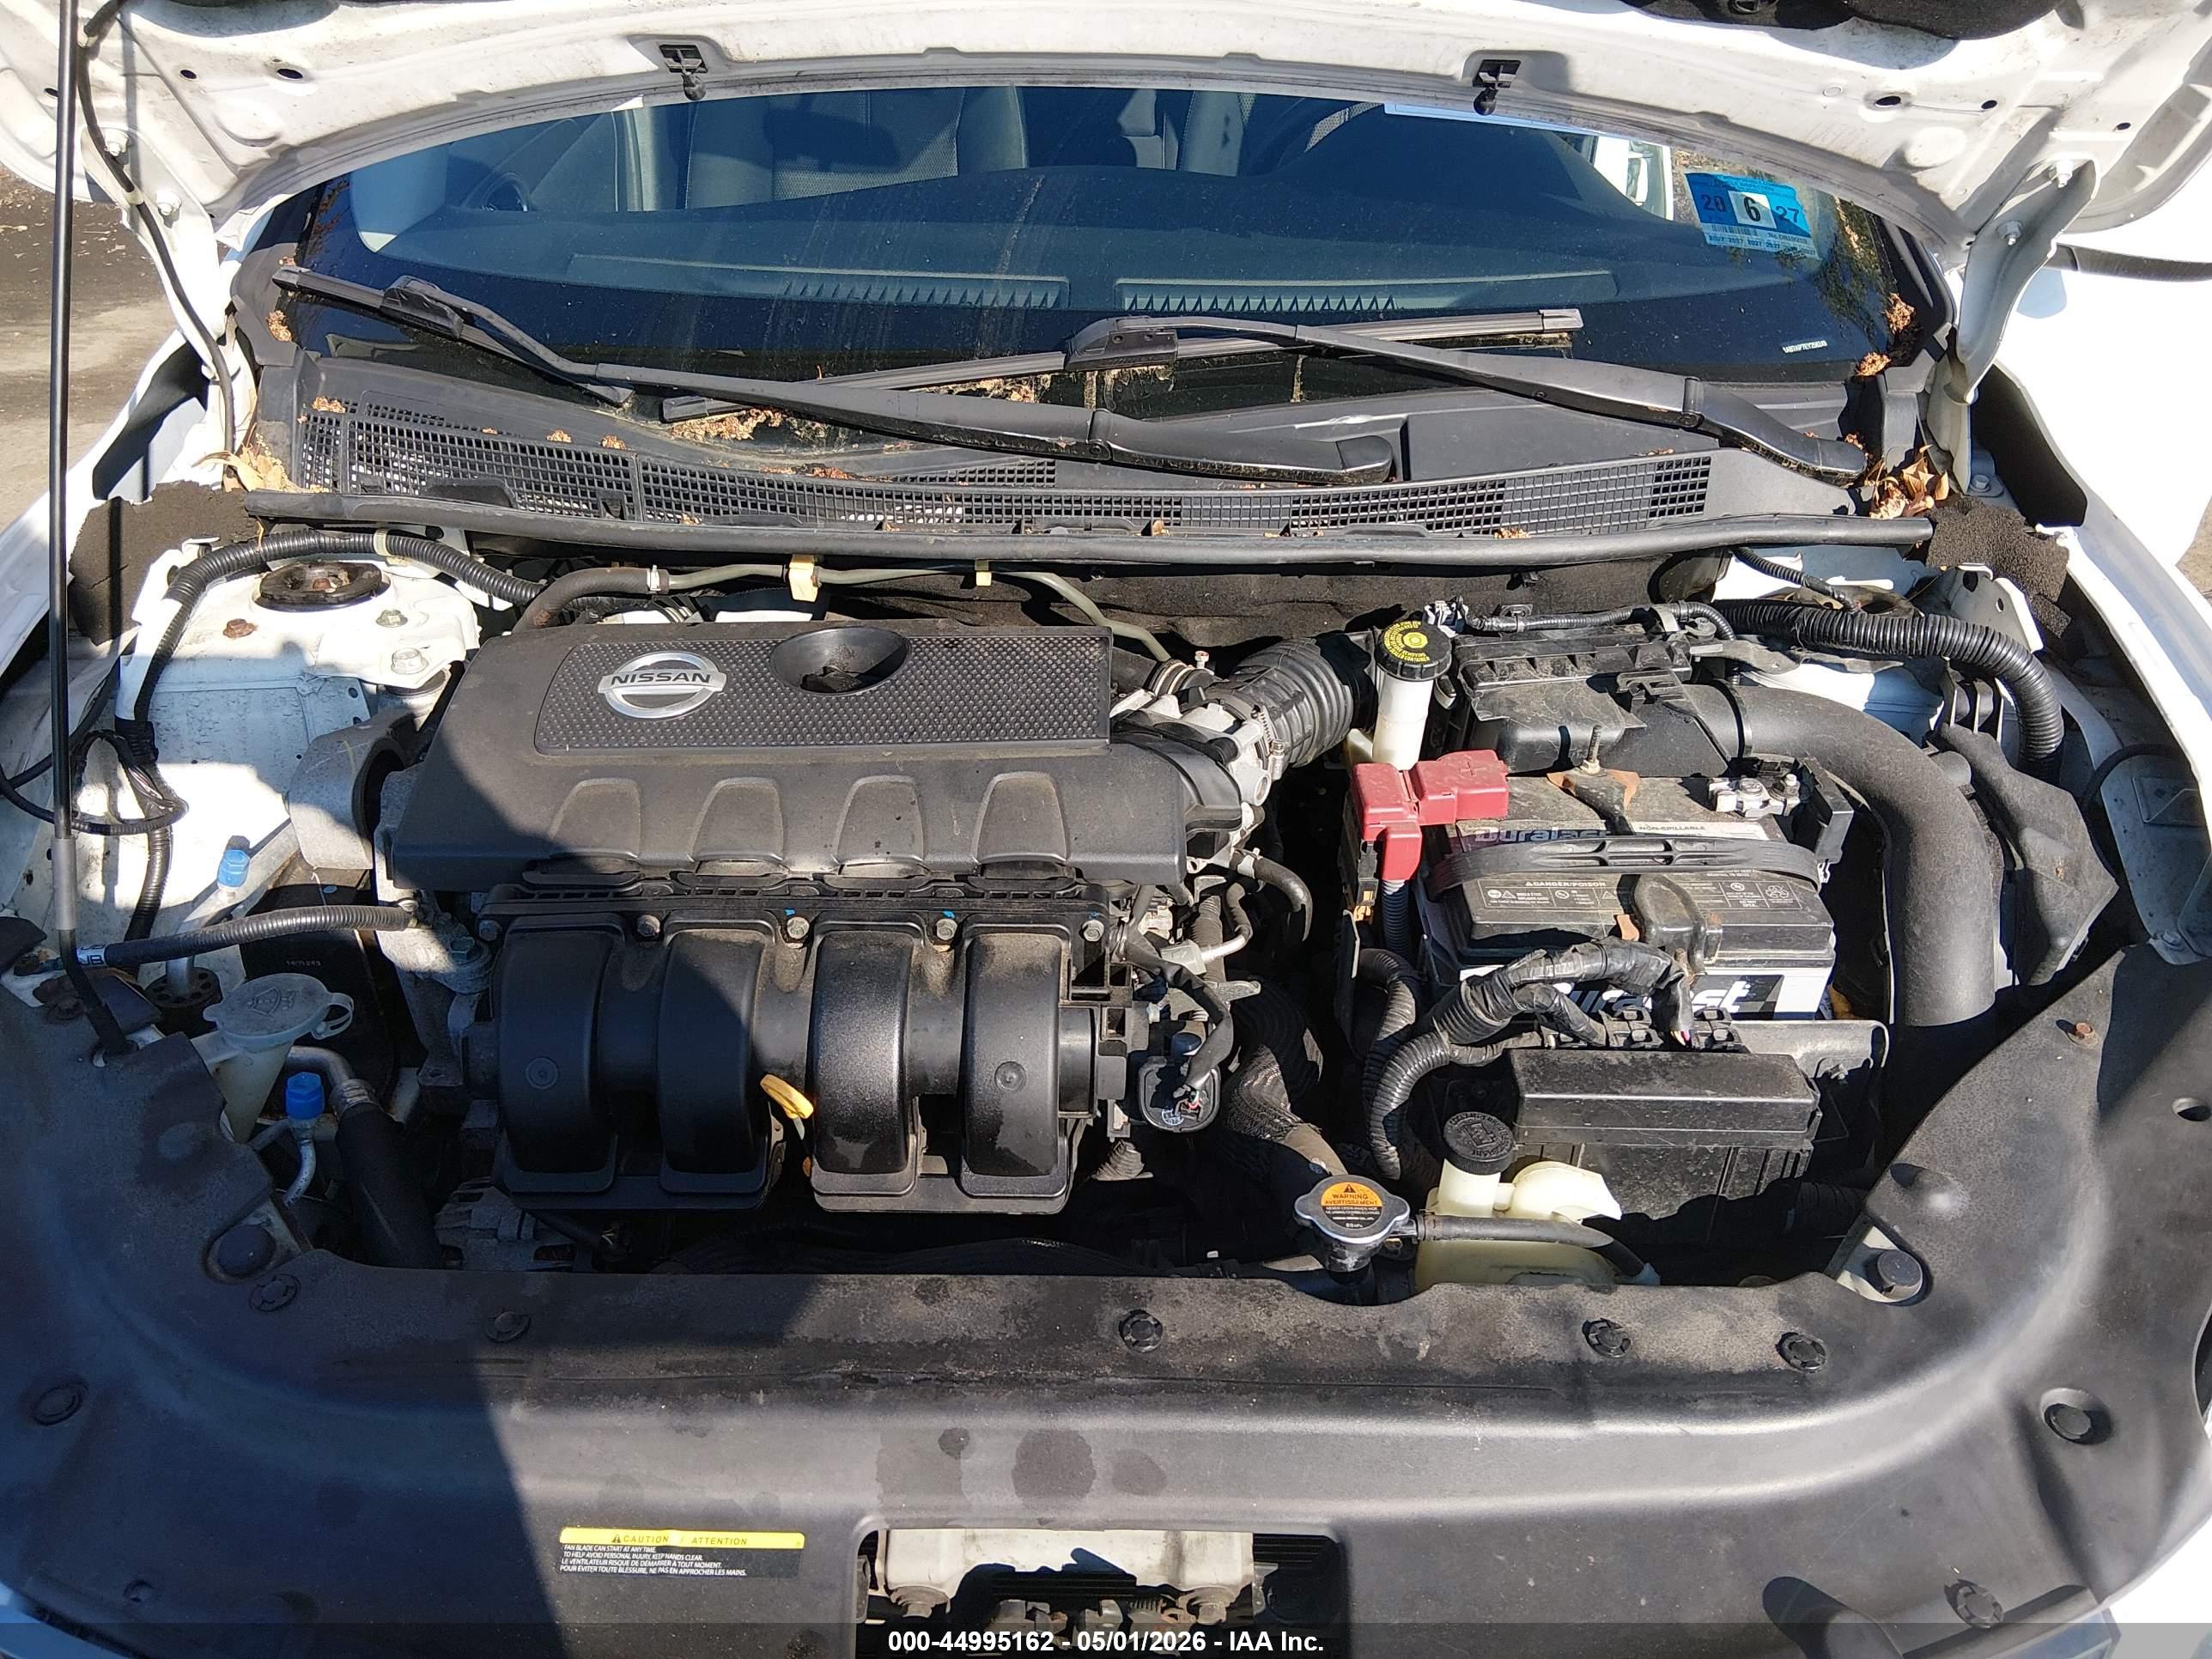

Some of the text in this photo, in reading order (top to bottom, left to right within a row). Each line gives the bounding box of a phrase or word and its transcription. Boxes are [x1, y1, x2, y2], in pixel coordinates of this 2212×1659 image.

[1700, 194, 1727, 212] 20
[1743, 196, 1761, 222] 6
[1776, 205, 1800, 223] 27
[611, 672, 711, 685] NISSAN
[623, 1534, 669, 1543] CAUTION
[690, 1536, 748, 1546] ATTENTION
